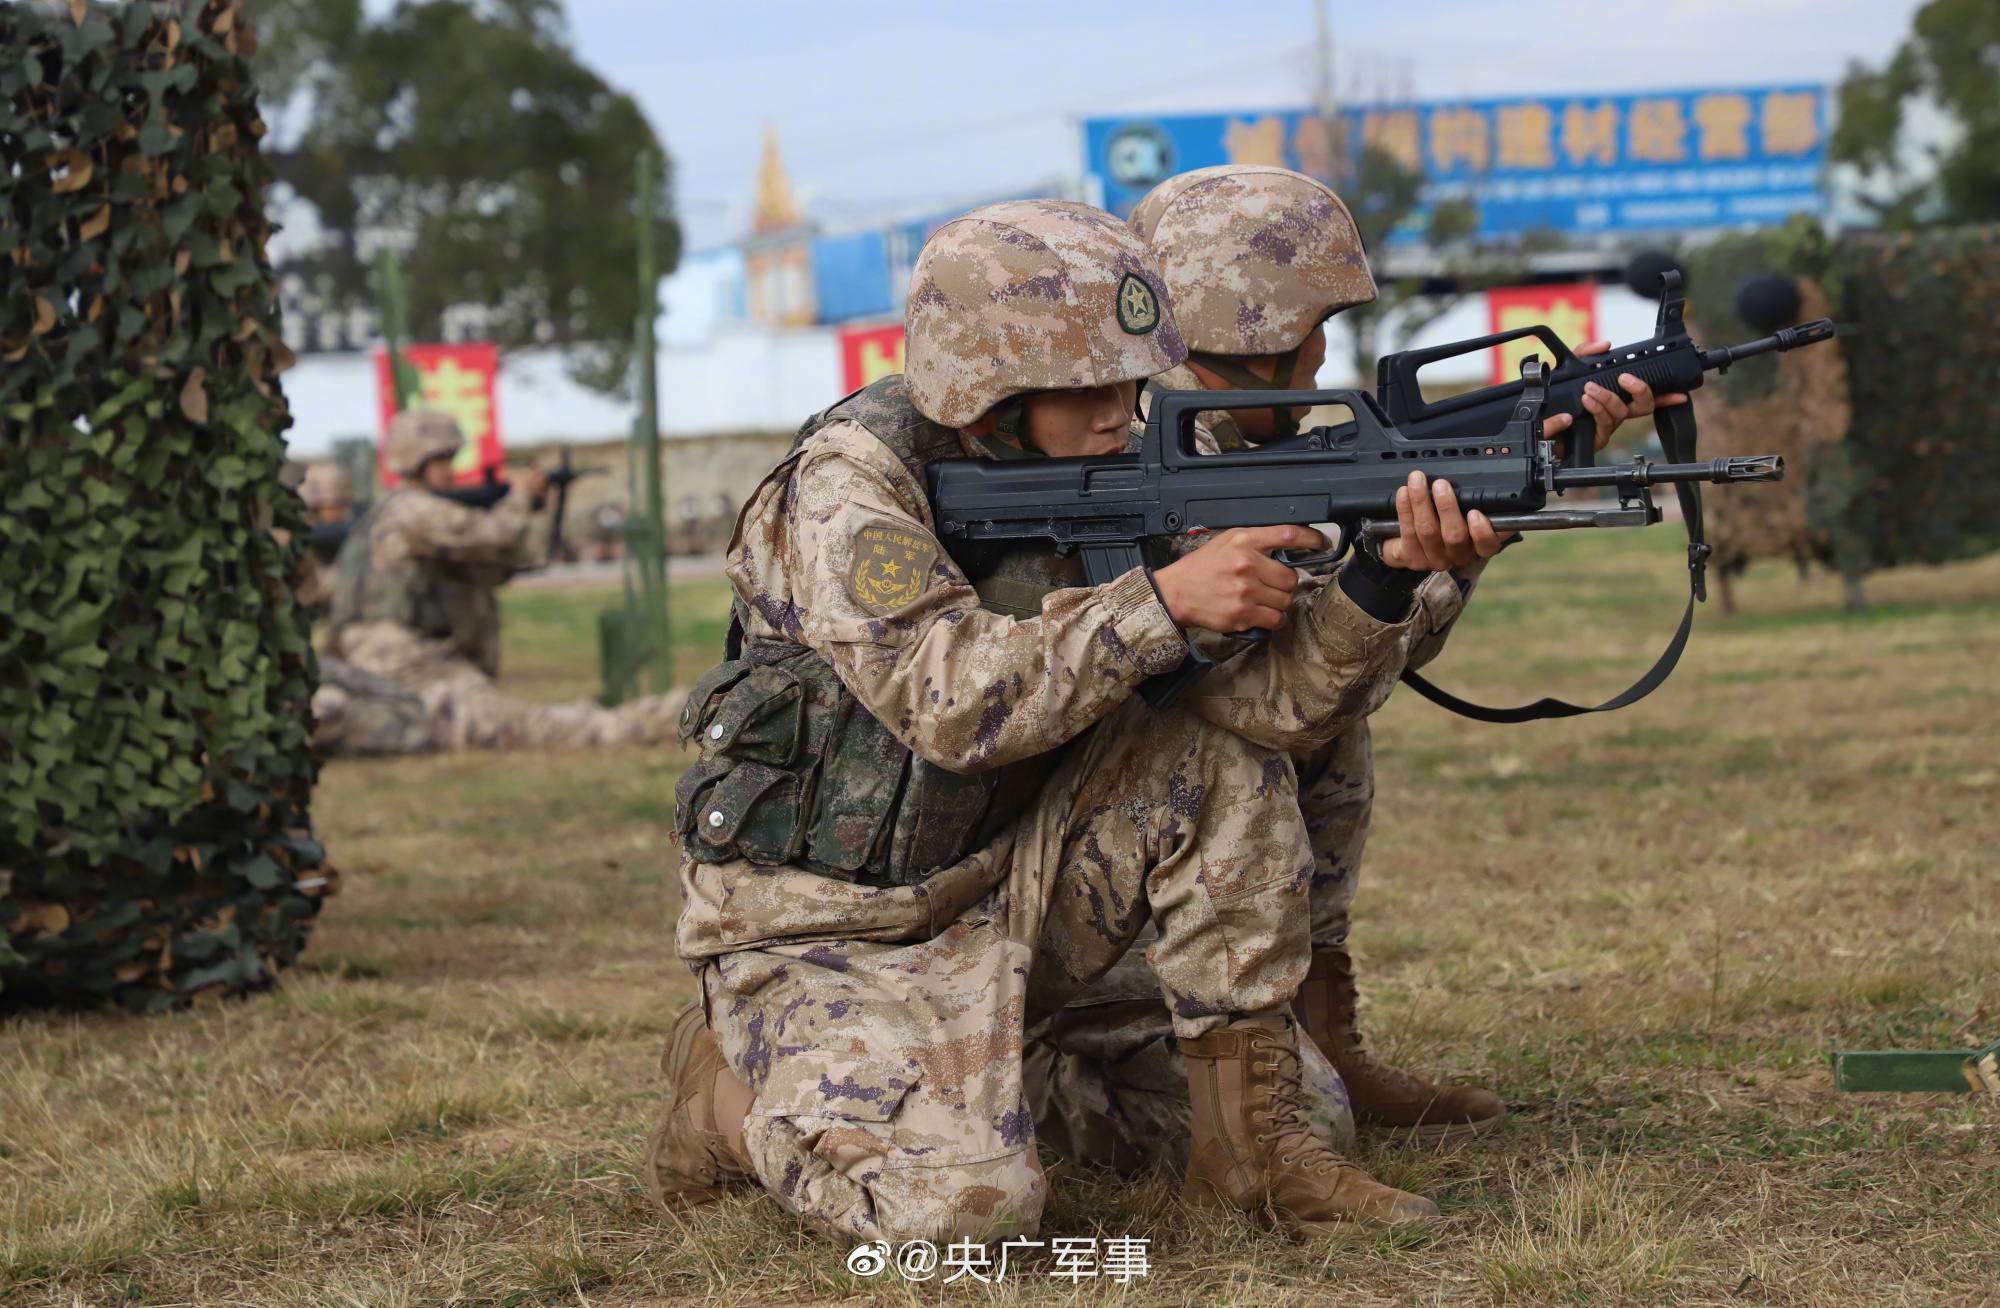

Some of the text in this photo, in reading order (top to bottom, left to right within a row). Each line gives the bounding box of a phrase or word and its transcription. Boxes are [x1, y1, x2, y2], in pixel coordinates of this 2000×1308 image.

[864, 530, 931, 552] 中国人民解放军
